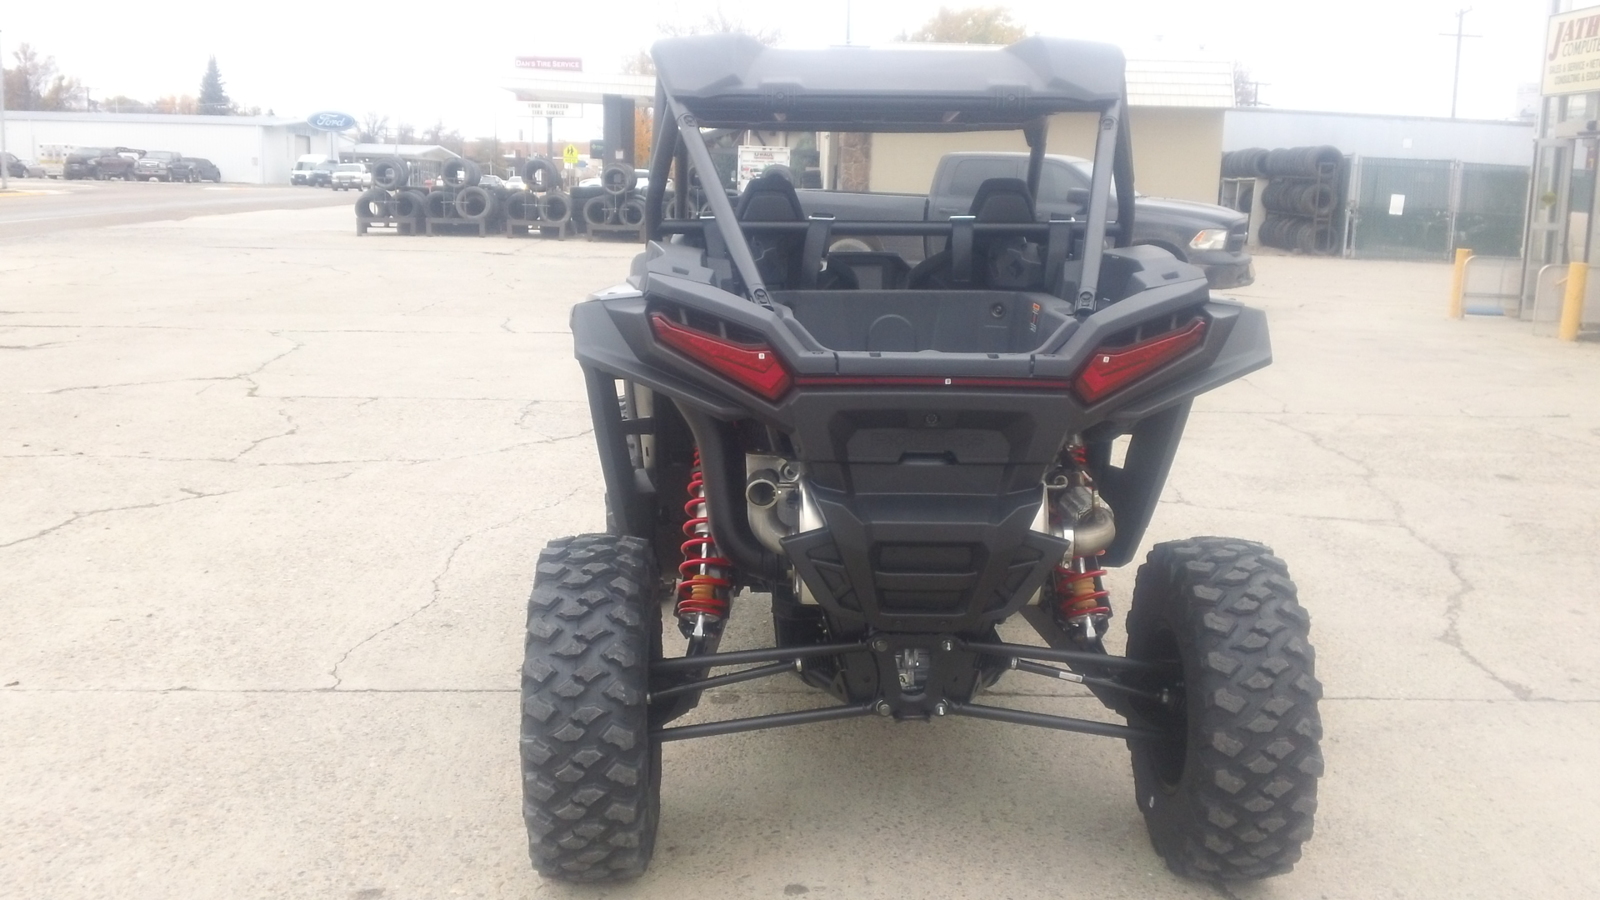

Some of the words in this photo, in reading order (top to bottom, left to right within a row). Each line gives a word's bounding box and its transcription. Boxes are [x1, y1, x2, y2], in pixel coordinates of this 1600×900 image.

[516, 59, 536, 67] DAN'S
[537, 60, 551, 68] TIRE
[552, 60, 580, 68] SERVICE
[316, 113, 346, 127] Ford
